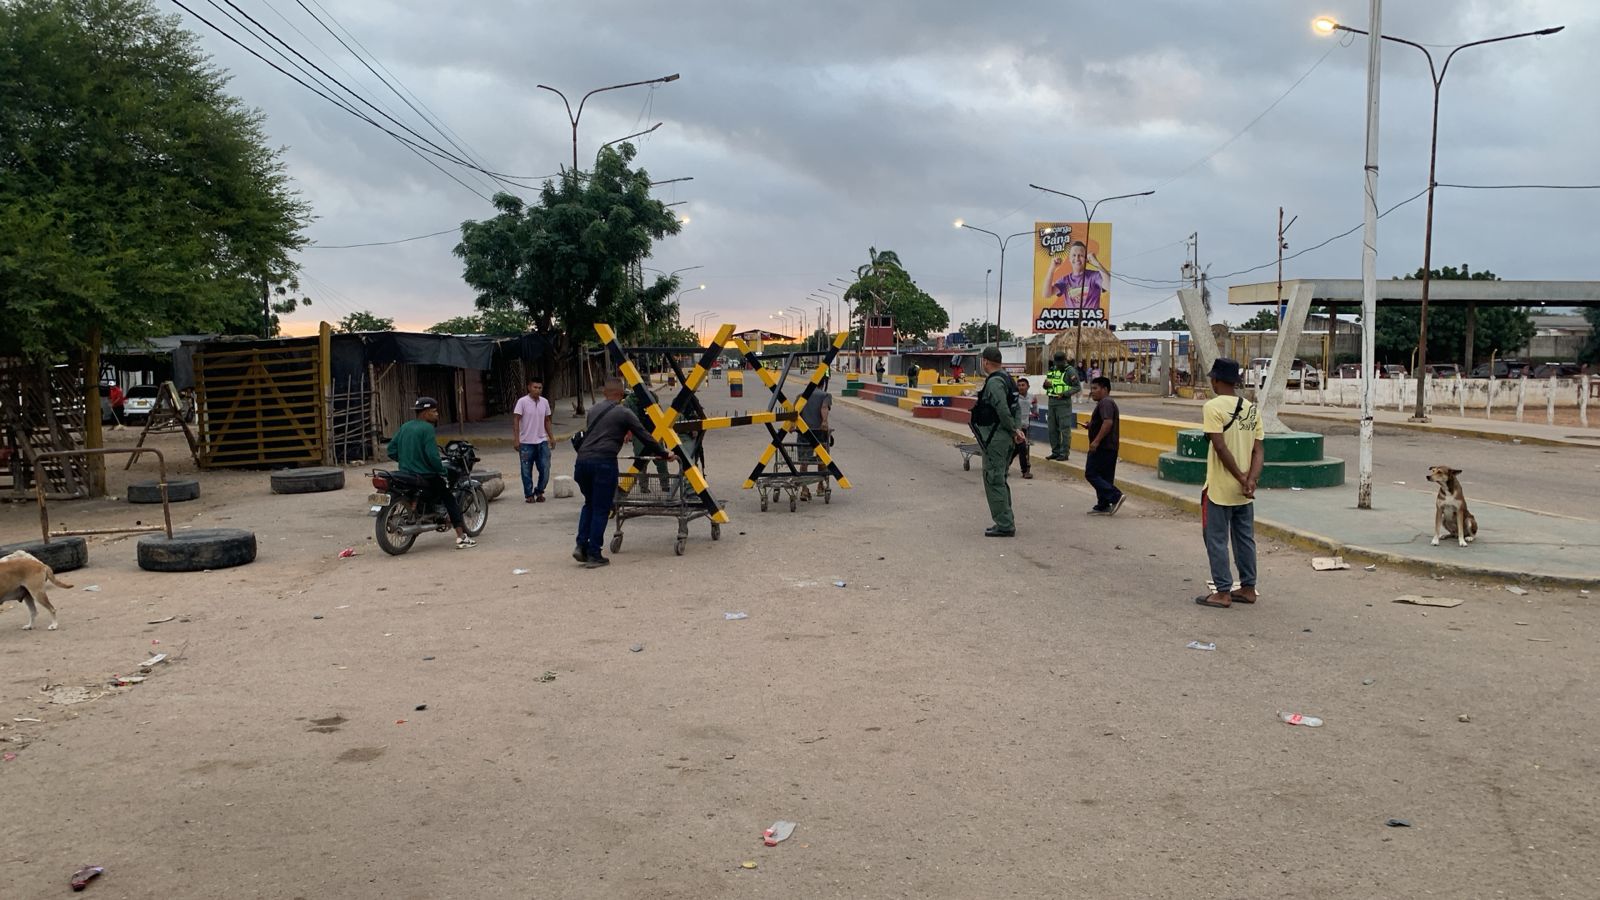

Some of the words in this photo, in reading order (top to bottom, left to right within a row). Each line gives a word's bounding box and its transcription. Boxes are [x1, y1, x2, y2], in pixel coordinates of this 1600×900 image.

[1040, 226, 1071, 236] Dcarga
[1042, 235, 1070, 246] Gana
[1041, 309, 1104, 319] APUESTAS
[1037, 320, 1107, 329] ROYALCOM
